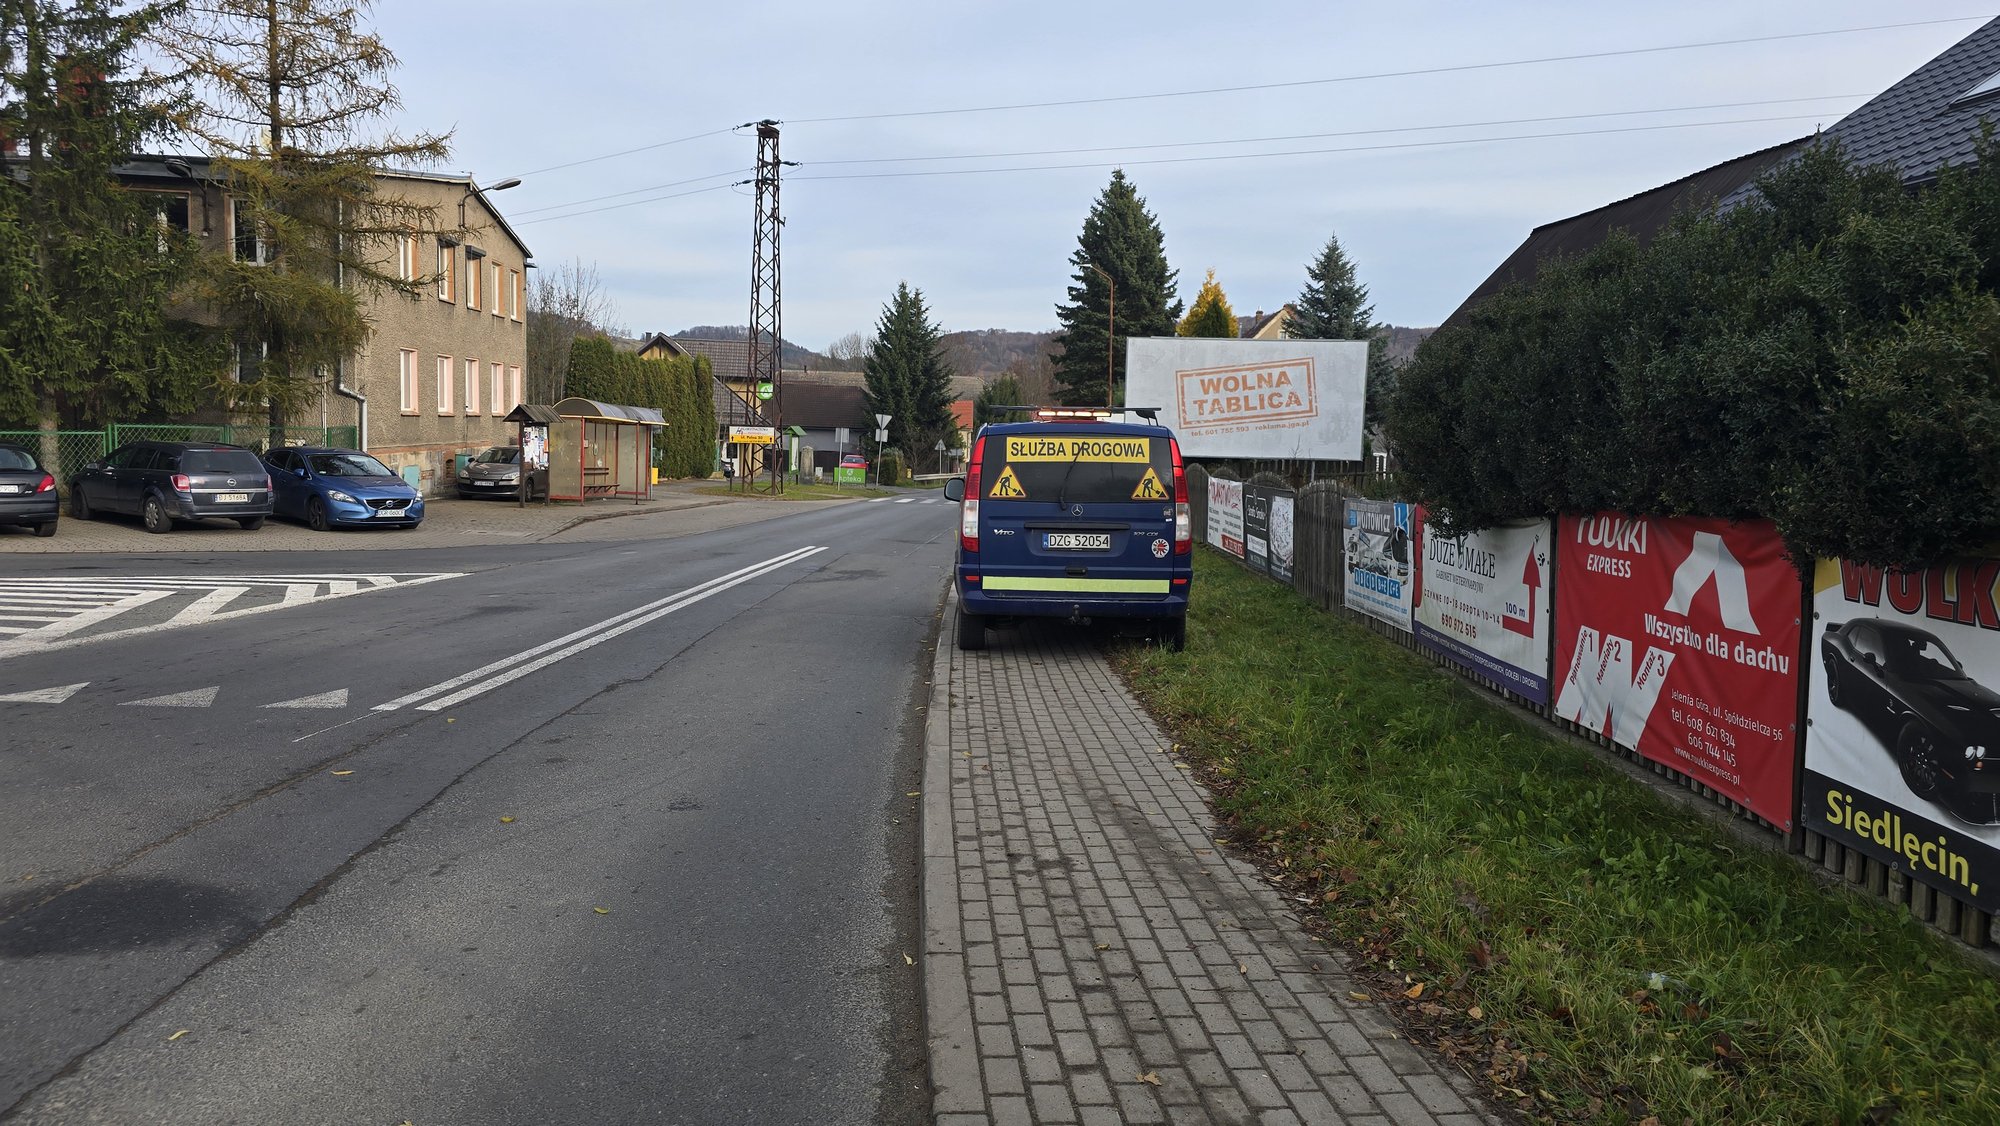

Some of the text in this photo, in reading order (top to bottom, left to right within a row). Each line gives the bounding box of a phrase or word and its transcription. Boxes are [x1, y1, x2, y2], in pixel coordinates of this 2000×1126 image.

[1200, 371, 1292, 395] WOLNA
[1193, 391, 1303, 416] TABLICA
[1011, 439, 1146, 458] SŁUŻBA DROGOWA
[1049, 535, 1109, 547] DZG 52054
[1465, 547, 1496, 579] MAŁE
[1587, 554, 1632, 578] EXPRESS
[1424, 588, 1442, 602] CZYNNE
[1460, 601, 1480, 617] SOBOTA
[1505, 601, 1526, 617] 100 m
[1441, 613, 1477, 639] 690 972 515
[1588, 631, 1593, 653] 1
[1613, 640, 1622, 663] 2
[1644, 613, 1789, 674] Wszystko dla dachu
[1596, 638, 1614, 685] Materiały
[1636, 649, 1657, 691] Montaż
[1657, 653, 1665, 677] 3
[1671, 688, 1694, 708] Jelenia
[1713, 706, 1723, 719] ul.
[1724, 709, 1771, 737] Spółdzielcza
[1772, 728, 1783, 741] 56
[1671, 708, 1736, 749] tel. 608 627 834
[1687, 732, 1737, 767] 606 744 145
[1826, 789, 1979, 897] Siedlęcin.
